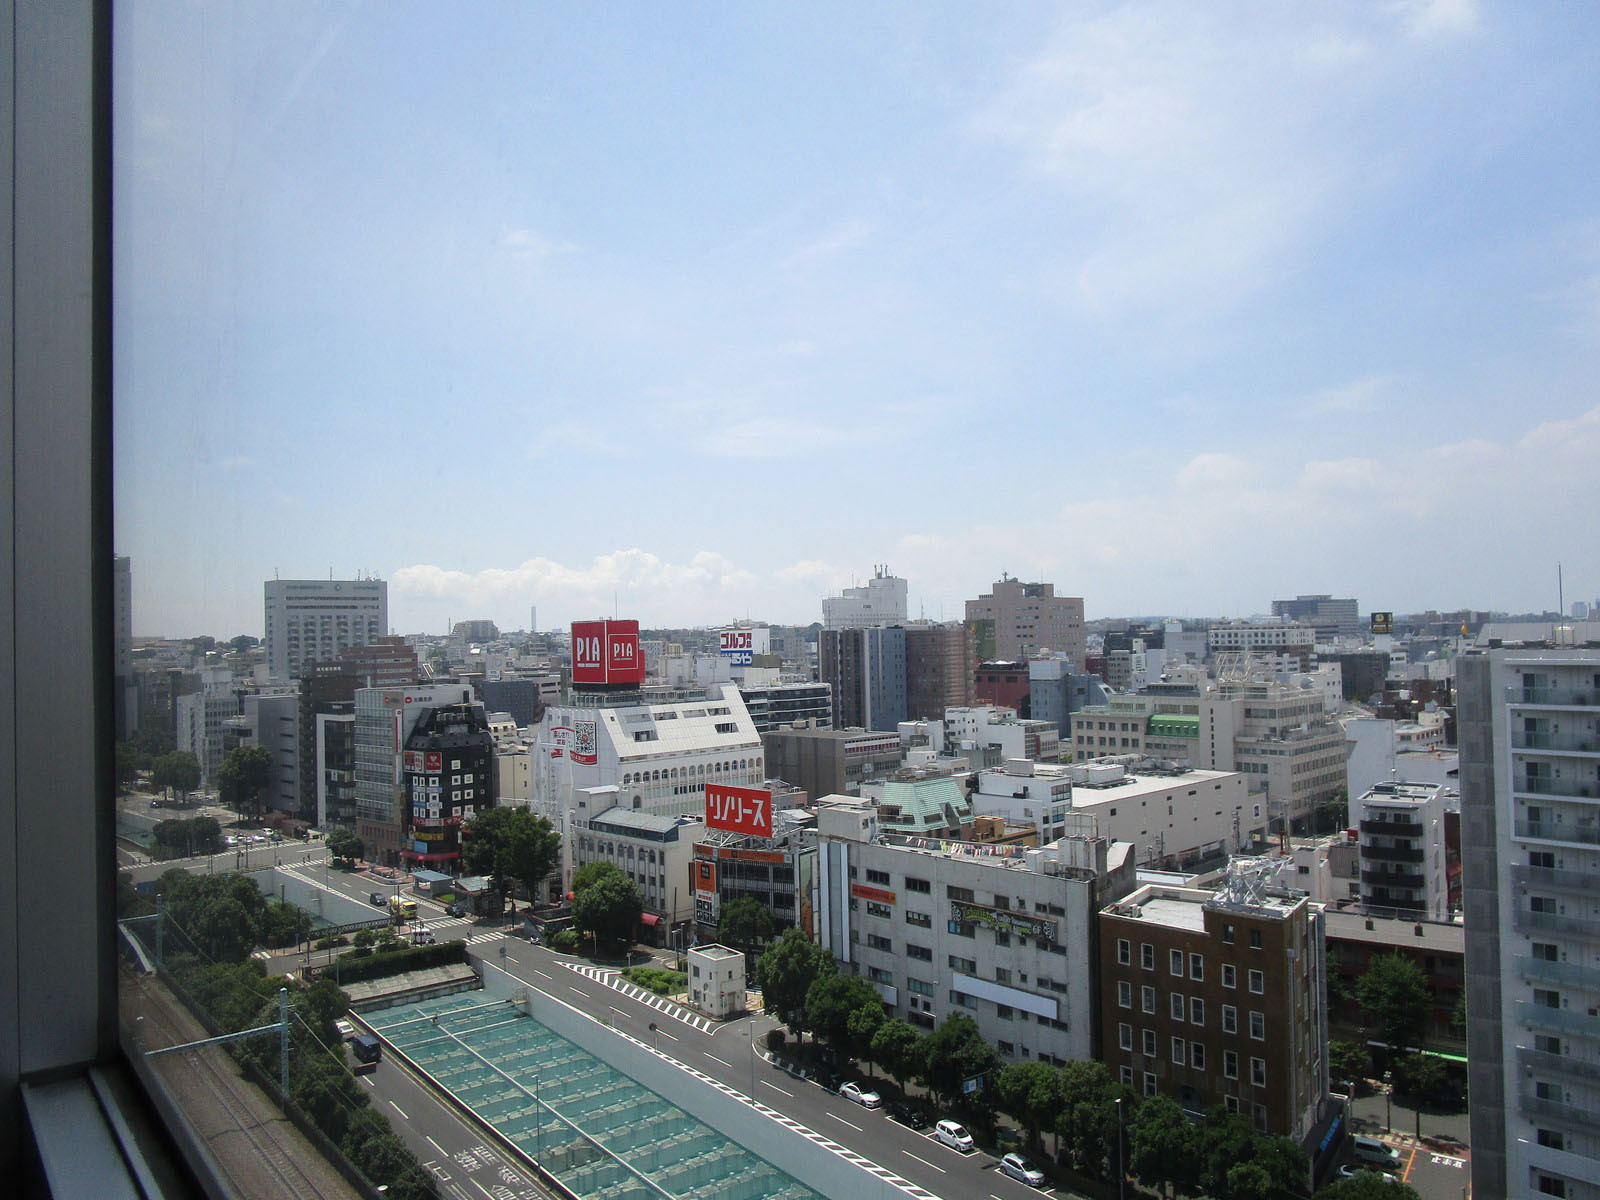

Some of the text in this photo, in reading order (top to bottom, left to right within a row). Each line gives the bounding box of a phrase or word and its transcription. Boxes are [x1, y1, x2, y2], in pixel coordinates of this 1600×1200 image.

[576, 637, 600, 661] PIA
[613, 642, 633, 657] PIA
[709, 793, 766, 827] リノリース
[1431, 1156, 1463, 1168] 止まれ
